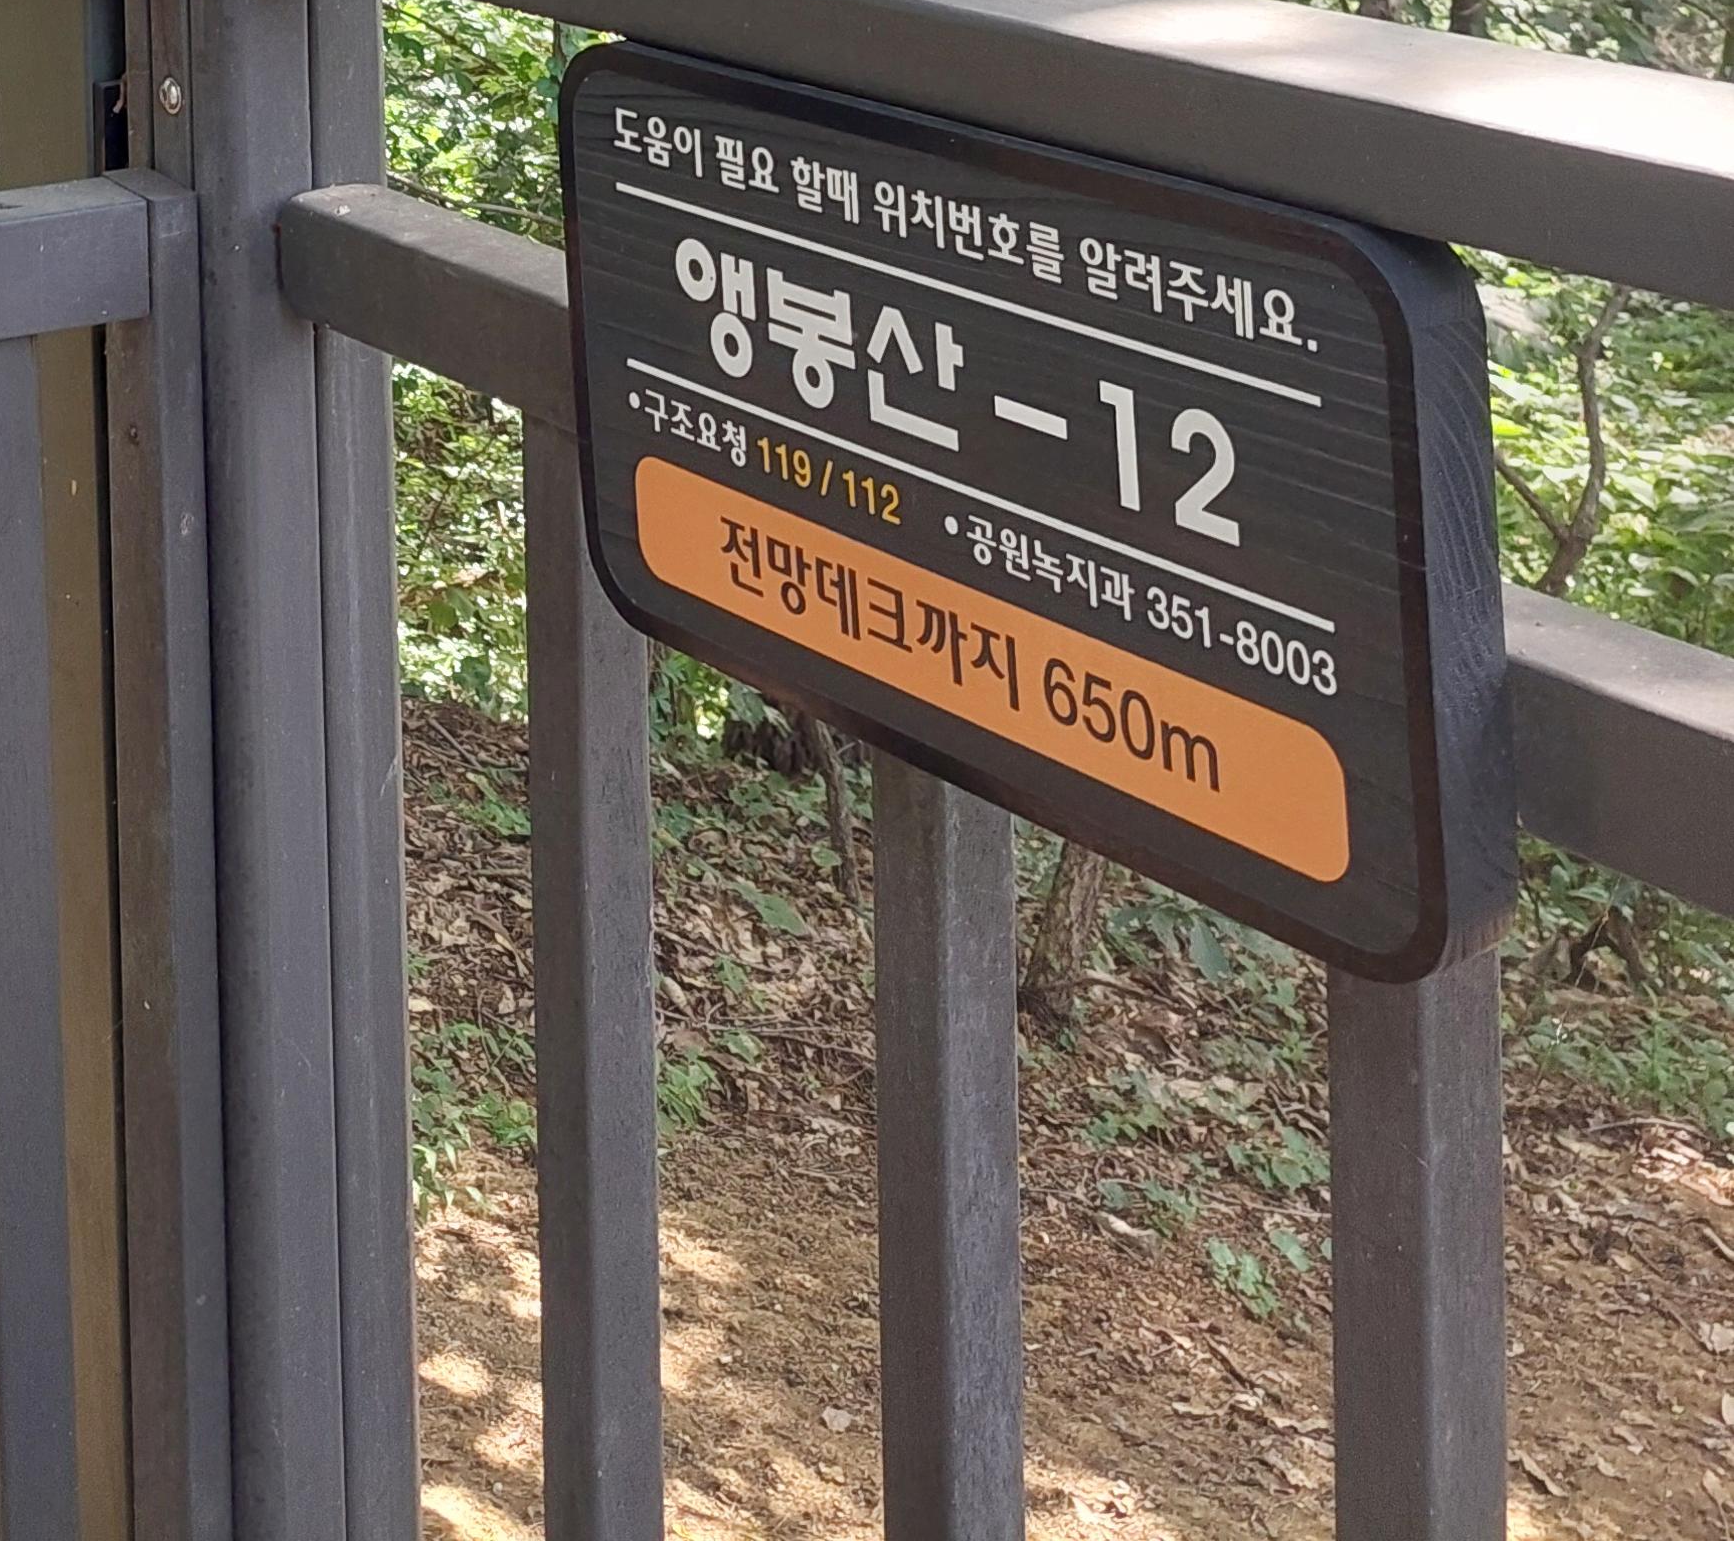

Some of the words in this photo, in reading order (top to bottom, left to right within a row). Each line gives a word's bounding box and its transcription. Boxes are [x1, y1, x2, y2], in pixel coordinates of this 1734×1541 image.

[613, 106, 703, 178] 도움이
[715, 134, 780, 194] 필요
[790, 156, 860, 224] 할때
[873, 180, 1064, 285] 위치번호를
[1078, 235, 1320, 353] 알려주세요.
[675, 237, 964, 453] 앵봉산
[720, 515, 1020, 712] 전망데크까지
[1043, 658, 1220, 793] 650m
[966, 514, 1135, 621] 공원녹지과
[1146, 585, 1338, 697] 351-8003
